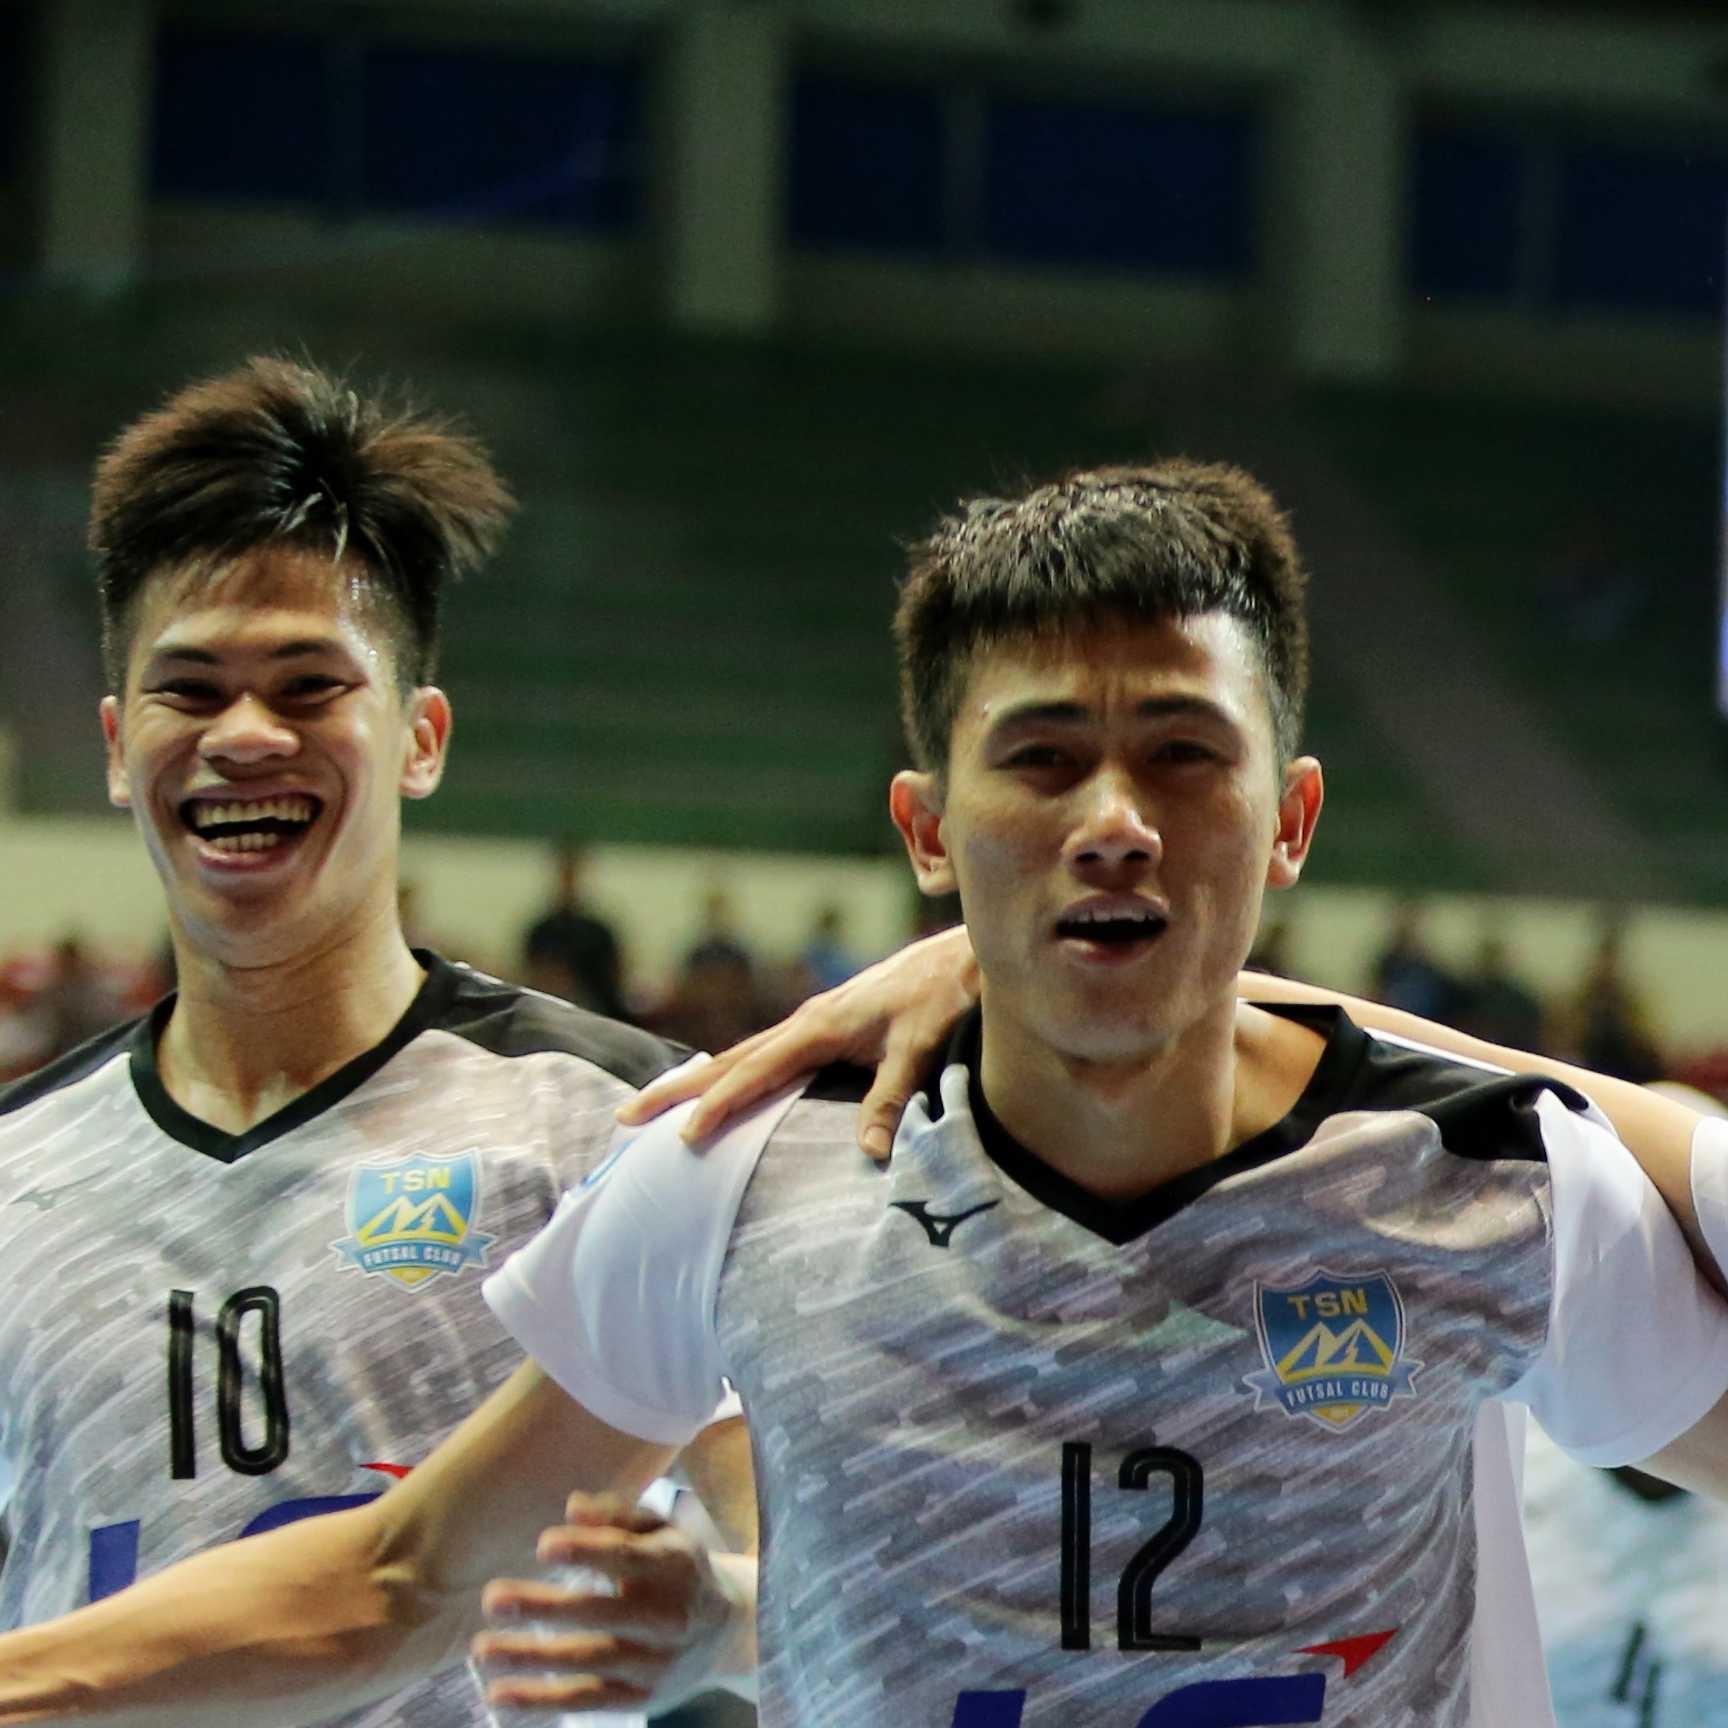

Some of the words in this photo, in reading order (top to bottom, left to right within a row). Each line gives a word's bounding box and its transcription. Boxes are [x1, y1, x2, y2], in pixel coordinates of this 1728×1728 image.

[380, 1167, 453, 1195] TSN
[1286, 1288, 1369, 1320] TSN
[168, 1285, 290, 1480] 10
[1286, 1381, 1344, 1407] FUTSAL
[1351, 1380, 1390, 1400] CLUB
[1060, 1442, 1207, 1652] 12
